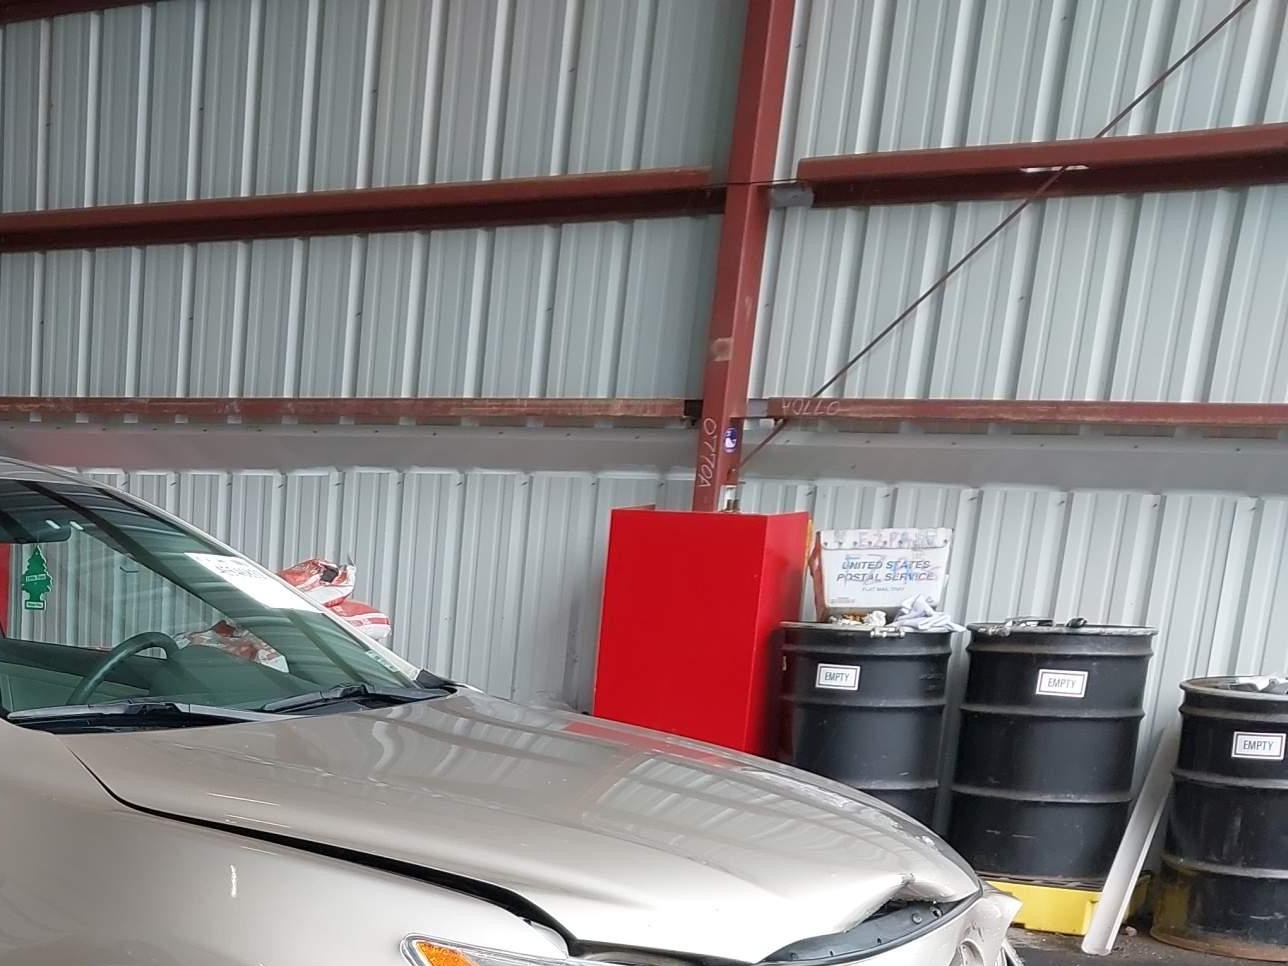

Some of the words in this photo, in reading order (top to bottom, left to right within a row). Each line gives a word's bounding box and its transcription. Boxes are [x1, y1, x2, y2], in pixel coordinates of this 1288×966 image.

[842, 561, 883, 570] UNITED
[885, 560, 930, 569] STATES
[836, 573, 881, 582] POSTAL
[884, 572, 935, 581] SERVICE
[824, 671, 850, 682] EMPTY
[1047, 677, 1077, 689] EMPTY
[1243, 739, 1274, 751] EMPTY
